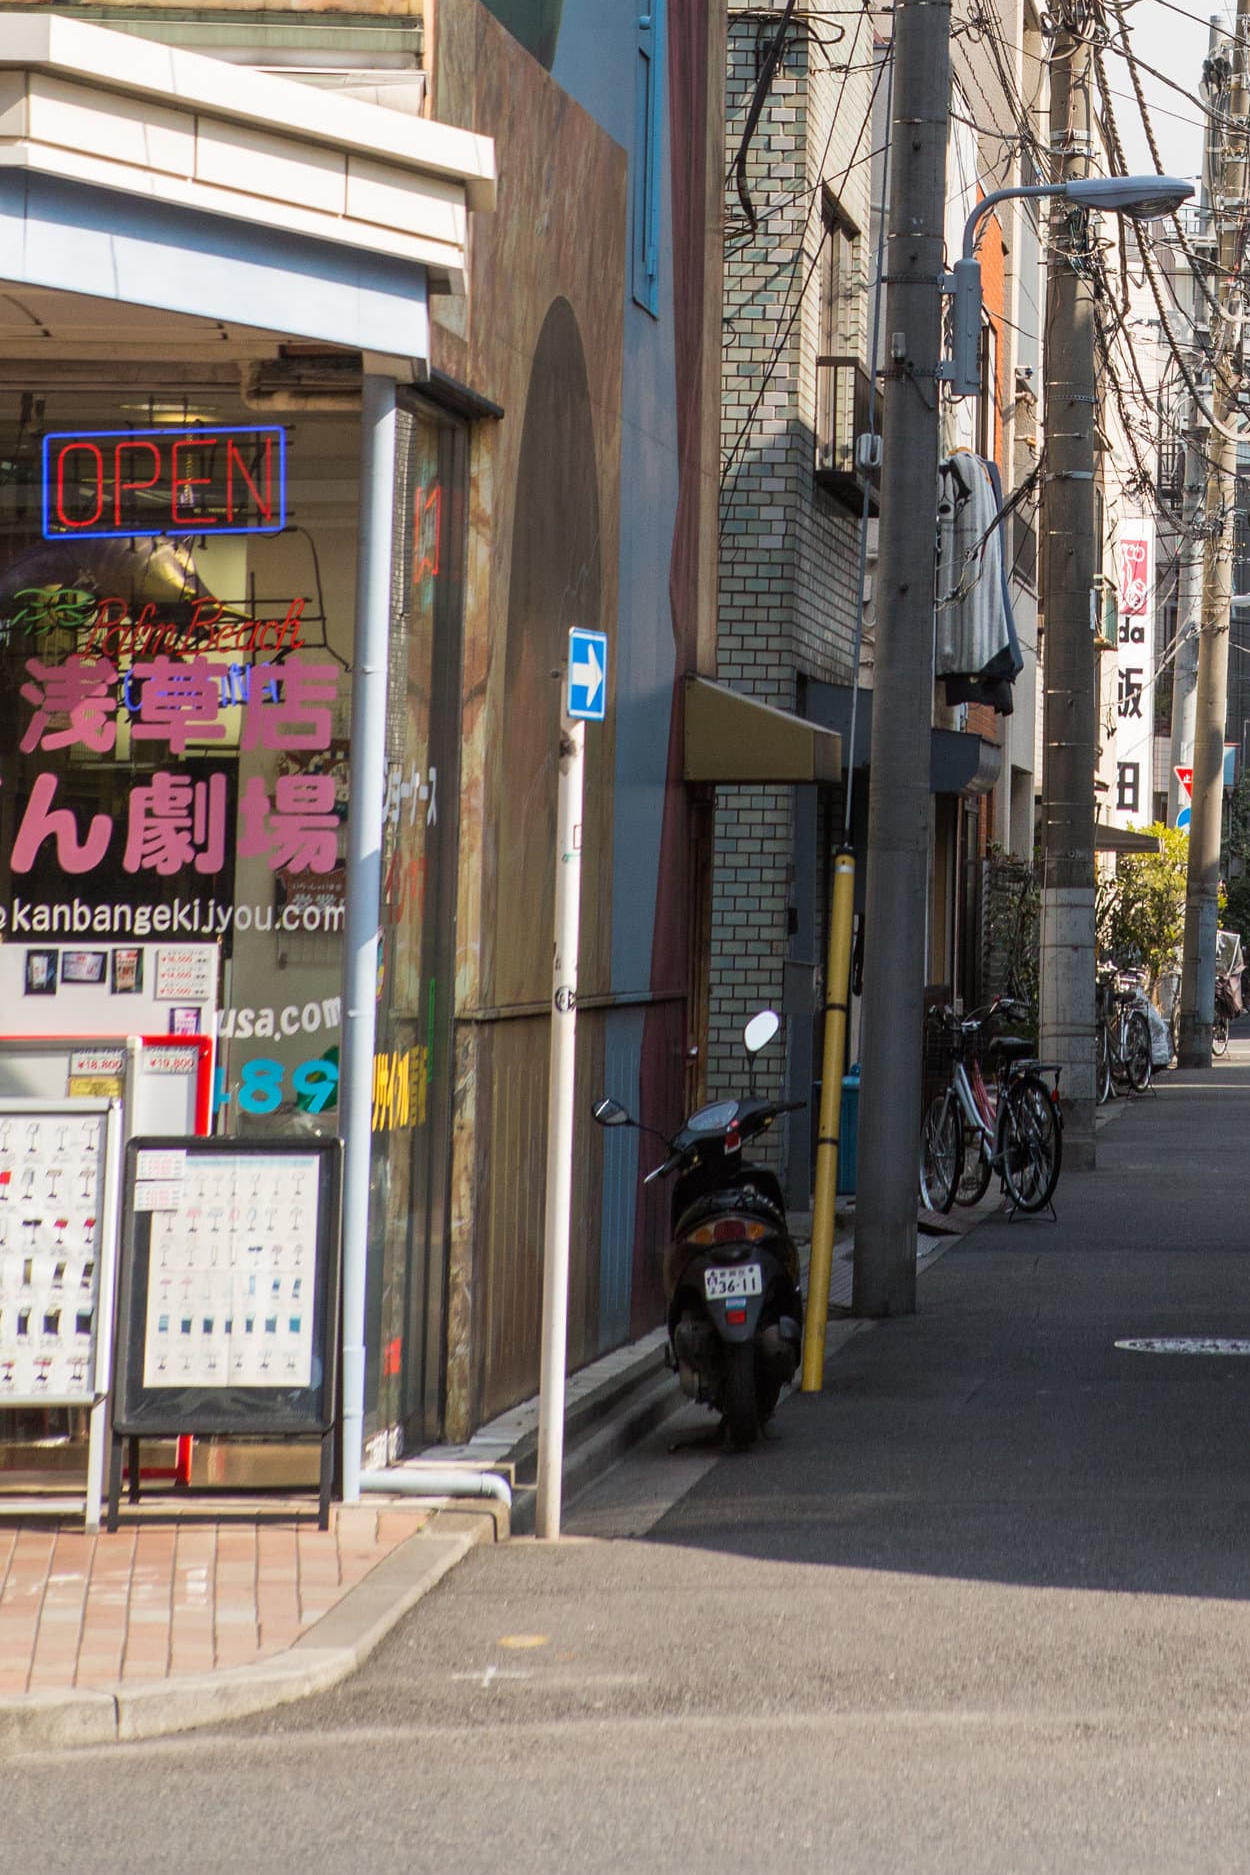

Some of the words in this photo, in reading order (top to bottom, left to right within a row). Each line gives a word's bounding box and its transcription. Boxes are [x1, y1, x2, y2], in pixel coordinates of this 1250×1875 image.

[55, 436, 273, 528] OPEN
[80, 596, 177, 659] Palm
[177, 596, 306, 656] Beach
[19, 654, 340, 754] 浅草店
[9, 772, 340, 875] ん劇場
